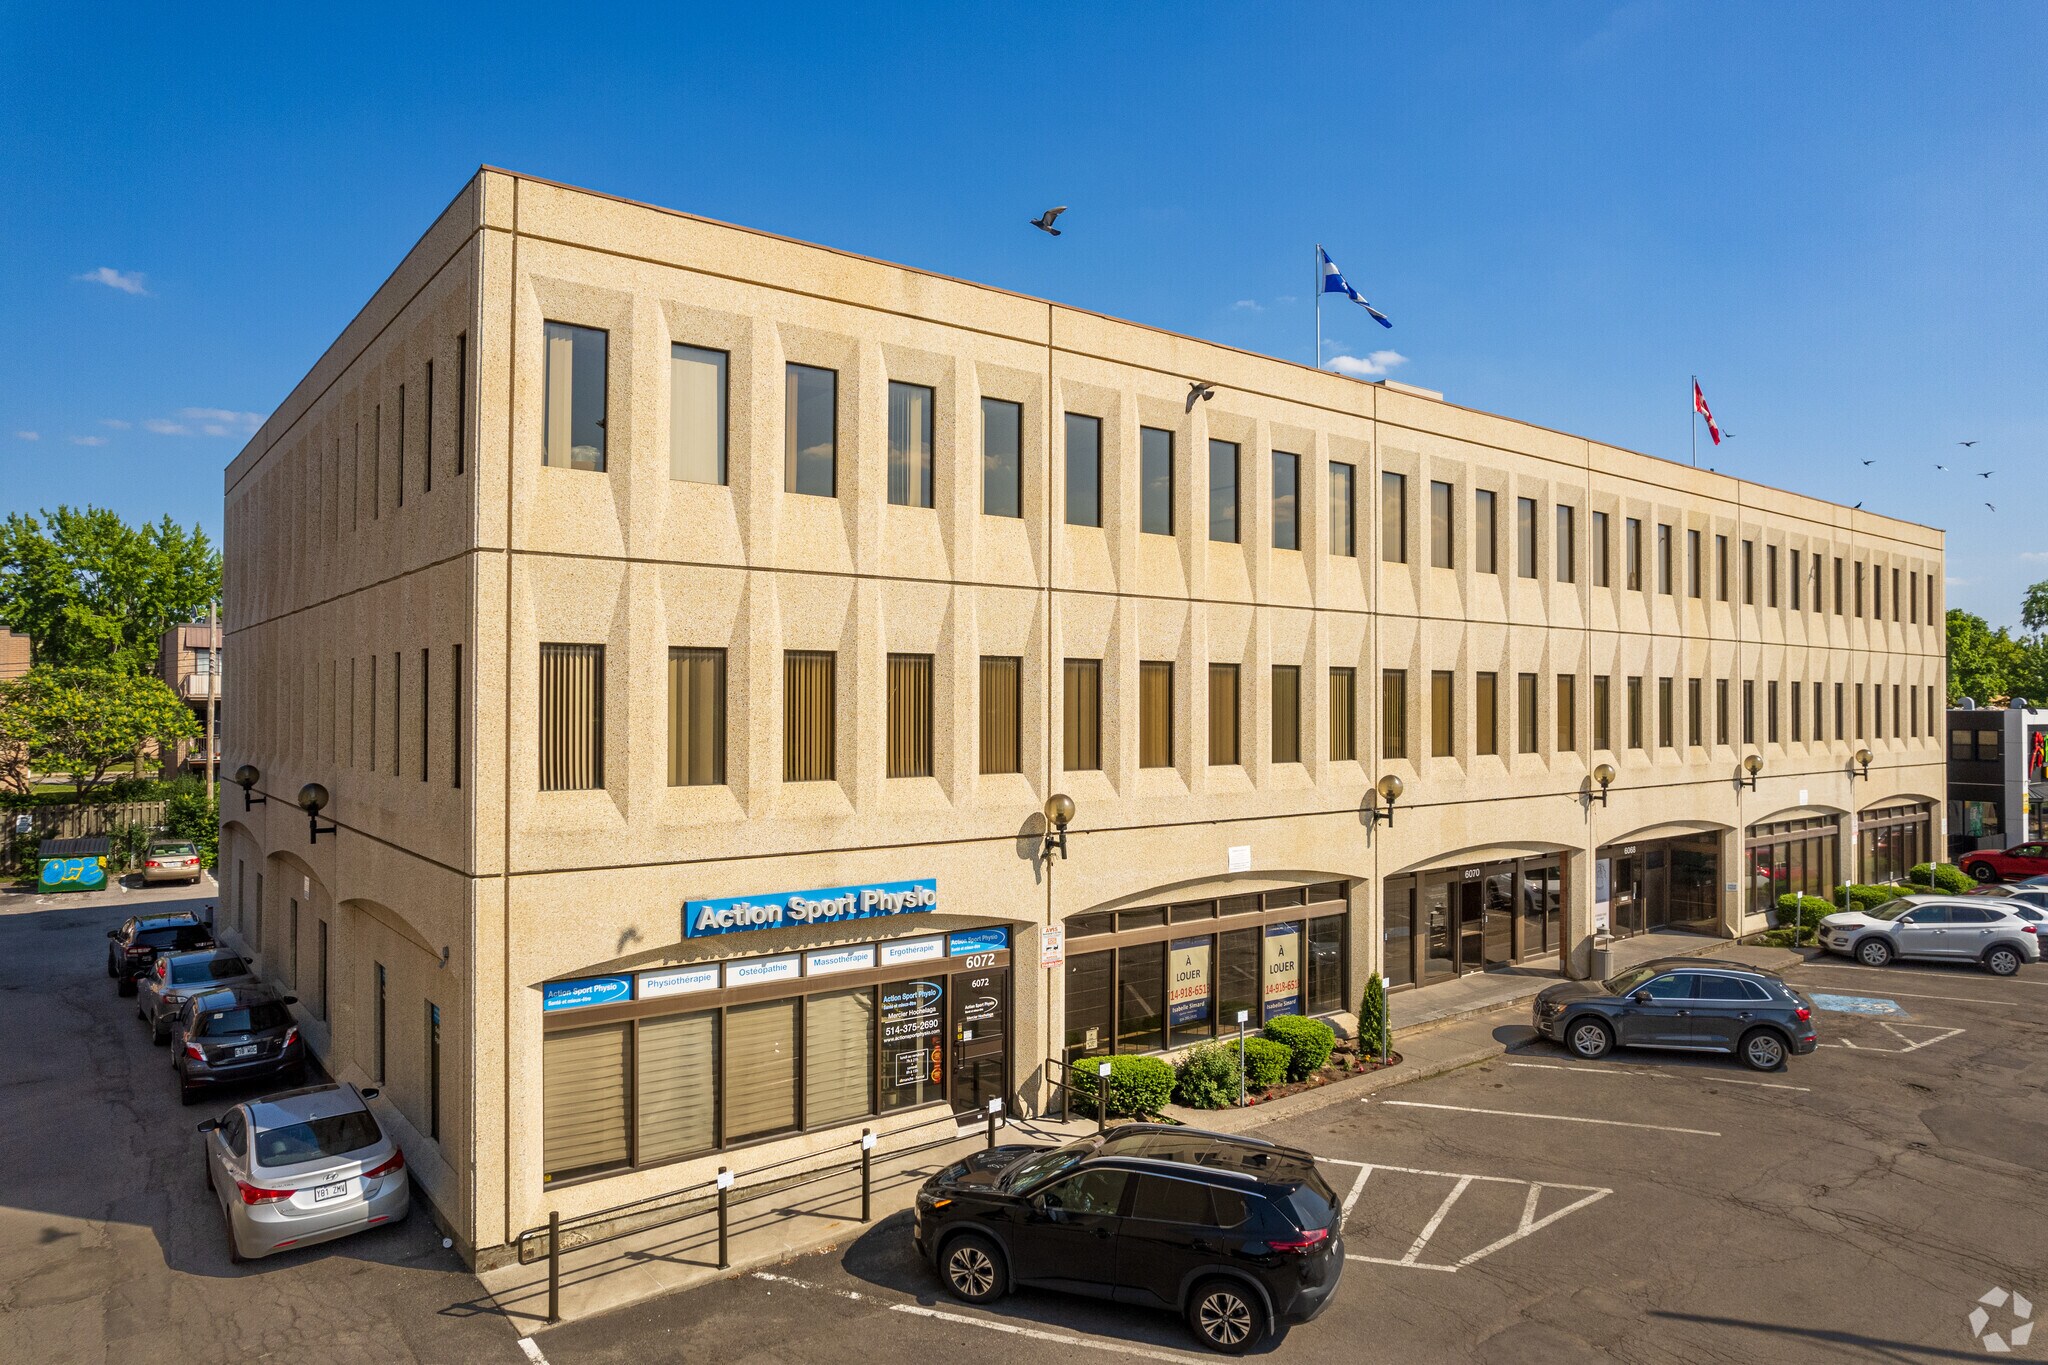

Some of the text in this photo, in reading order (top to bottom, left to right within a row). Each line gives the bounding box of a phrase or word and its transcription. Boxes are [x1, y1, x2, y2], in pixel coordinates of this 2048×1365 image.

[1464, 868, 1480, 878] 6070
[696, 885, 936, 930] Action Sport Physio
[968, 936, 981, 944] Sport
[889, 943, 934, 957] Ergothérapie
[1278, 945, 1284, 957] À
[813, 953, 868, 966] Massothérapie
[966, 953, 995, 969] 6072
[1186, 955, 1192, 966] À
[738, 962, 788, 978] Ostéopathie
[1269, 961, 1295, 975] LOUER
[647, 973, 712, 991] Physiothérapie
[1176, 969, 1201, 982] LOUER
[971, 978, 990, 988] 6072
[548, 983, 617, 998] Action Sport Physio
[883, 989, 936, 1003] Action Sport Physio
[888, 1011, 908, 1019] Mercier
[885, 1019, 939, 1036] 514-375-2690
[332, 1183, 345, 1195] ZMV
